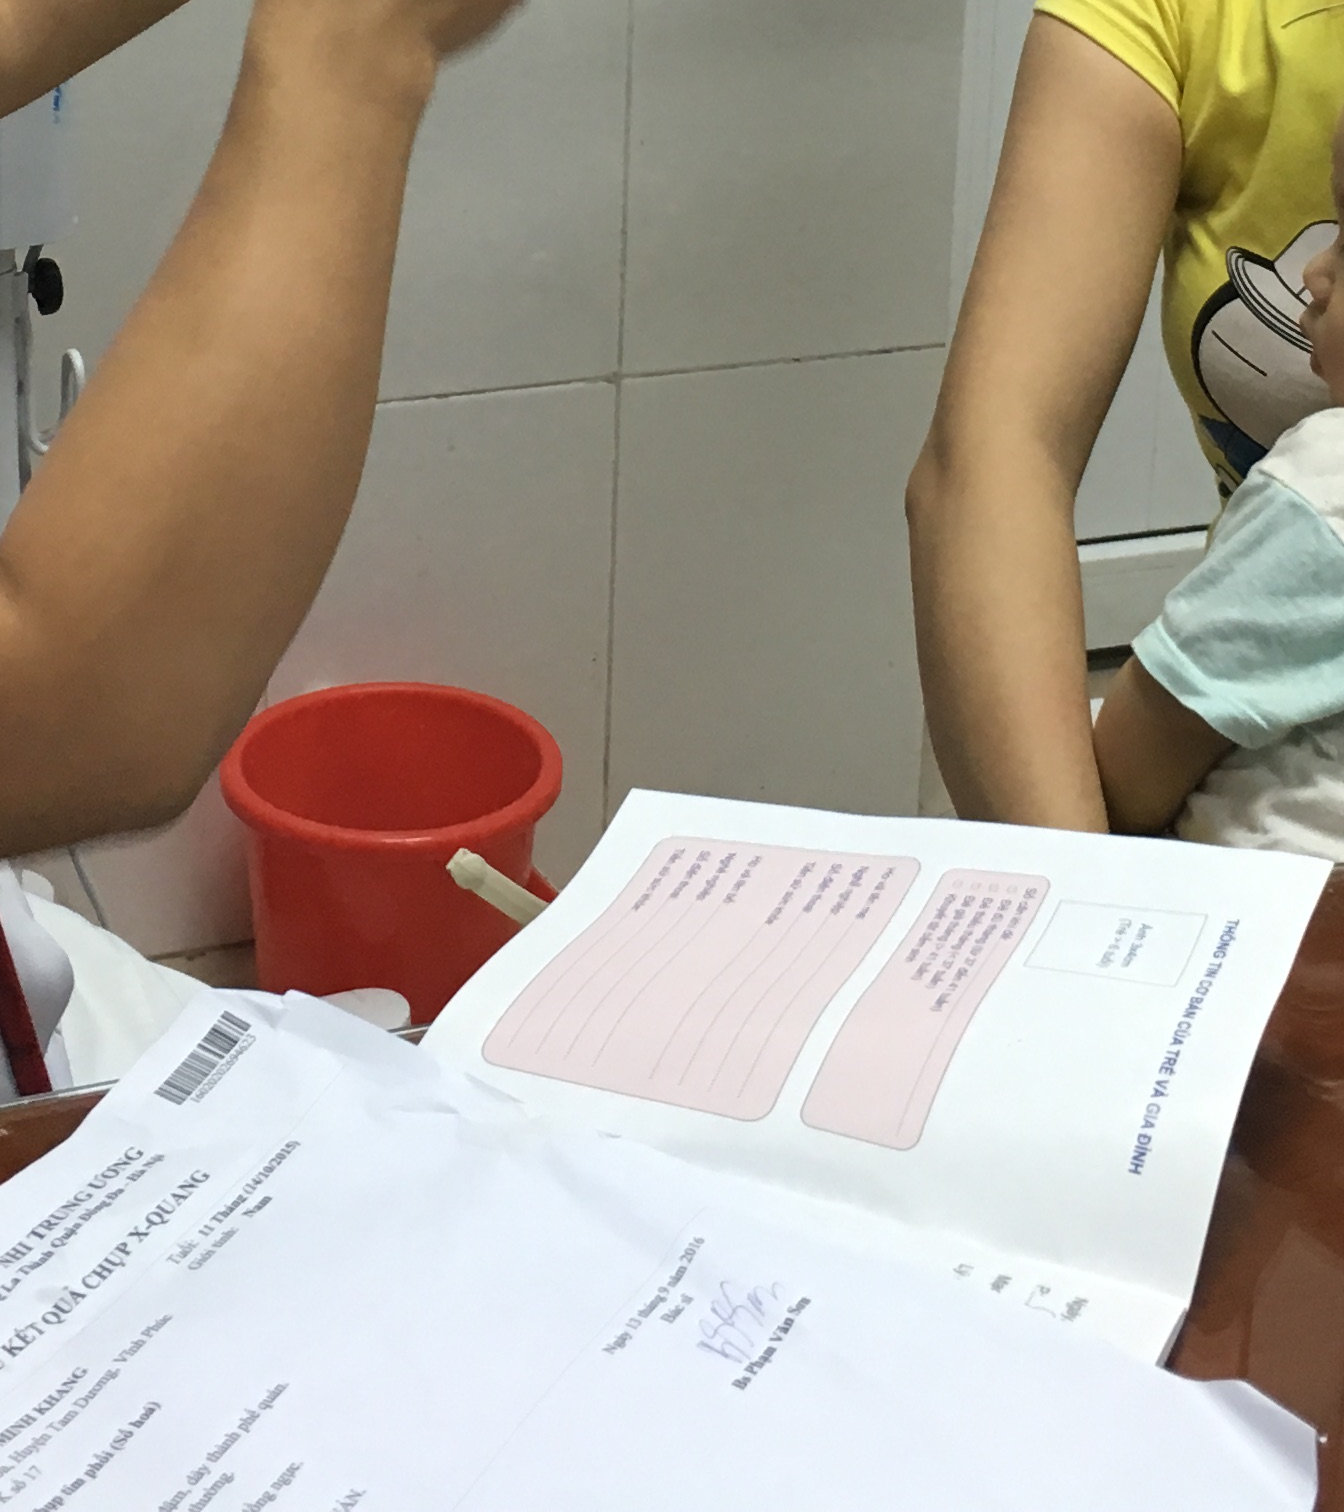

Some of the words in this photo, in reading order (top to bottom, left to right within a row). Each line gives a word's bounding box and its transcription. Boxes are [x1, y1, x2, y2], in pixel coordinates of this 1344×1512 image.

[1212, 919, 1241, 960] THÔNG
[1203, 961, 1223, 979] TIN
[1150, 1079, 1170, 1098] VÀ
[1140, 1102, 1162, 1129] GIA
[25, 1190, 94, 1241] TRUNG
[240, 1195, 273, 1219] Nam
[0, 1321, 46, 1358] KẾT
[41, 1285, 88, 1325] QUẢ
[81, 1241, 132, 1290] CHỤP
[128, 1169, 211, 1244] X-QUANG
[625, 1317, 643, 1331] 13
[678, 1236, 706, 1265] 2016
[31, 1366, 88, 1416] KHANG
